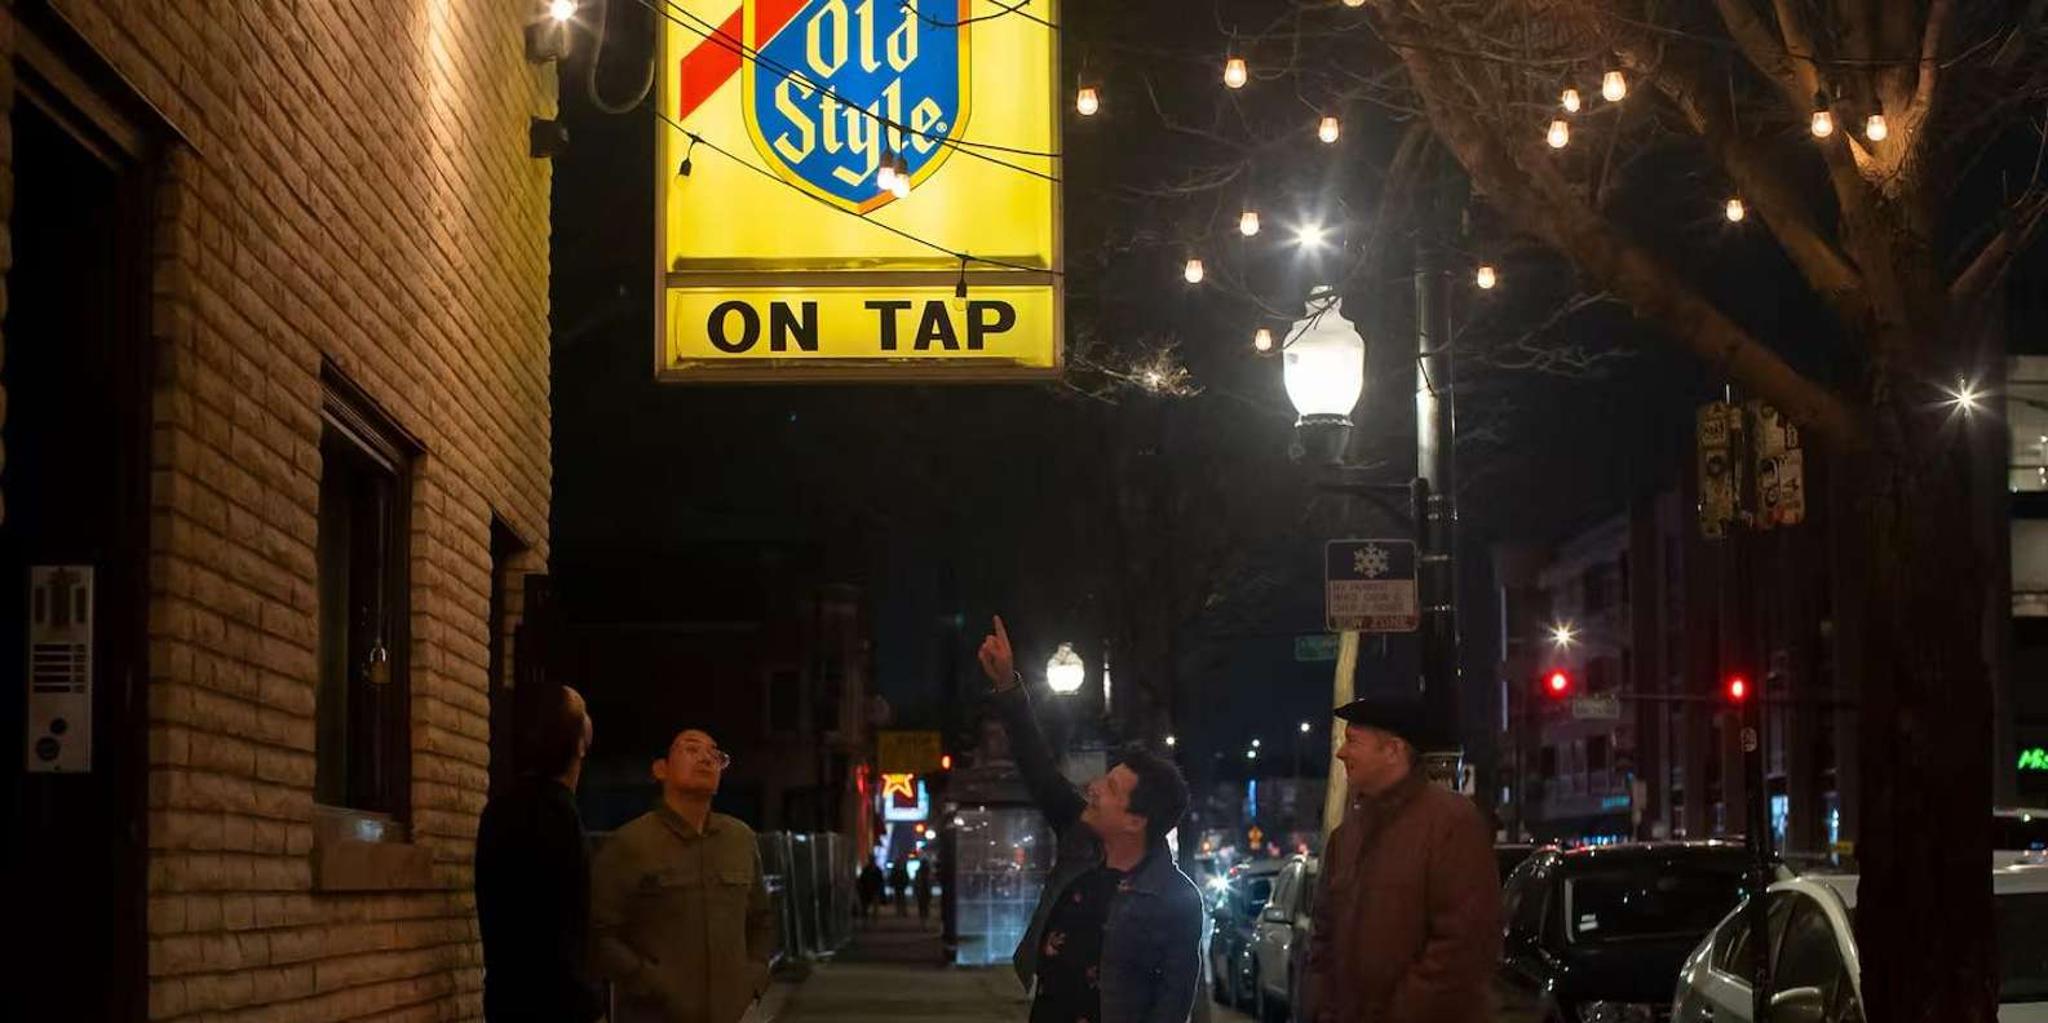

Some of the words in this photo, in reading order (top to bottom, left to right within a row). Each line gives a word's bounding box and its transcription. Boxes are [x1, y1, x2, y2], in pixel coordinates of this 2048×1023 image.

[806, 0, 918, 77] Old
[707, 300, 818, 354] ON
[864, 300, 1018, 352] TAP
